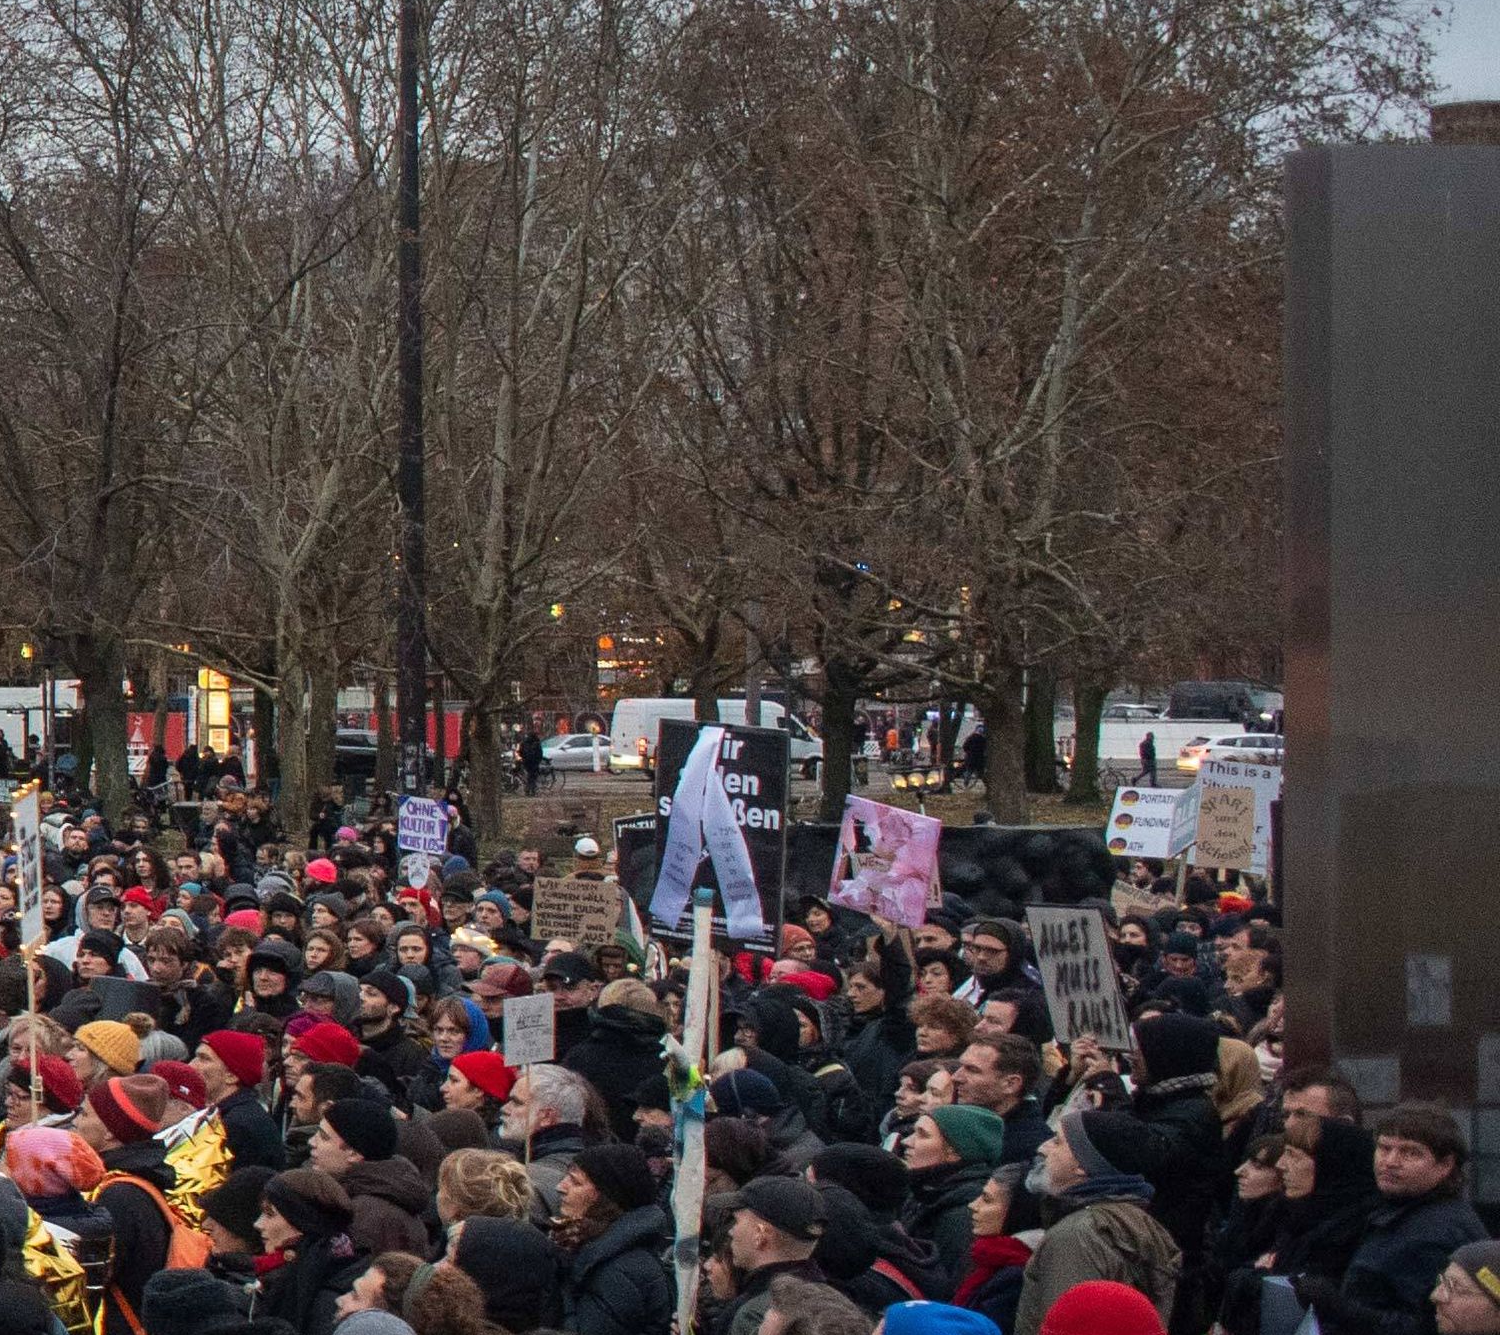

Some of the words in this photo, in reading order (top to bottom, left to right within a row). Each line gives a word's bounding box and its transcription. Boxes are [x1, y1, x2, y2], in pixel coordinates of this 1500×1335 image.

[722, 733, 744, 760] ir
[1209, 760, 1239, 776] This
[1244, 767, 1257, 777] is
[1262, 770, 1271, 779] a
[407, 801, 438, 818] OHNE
